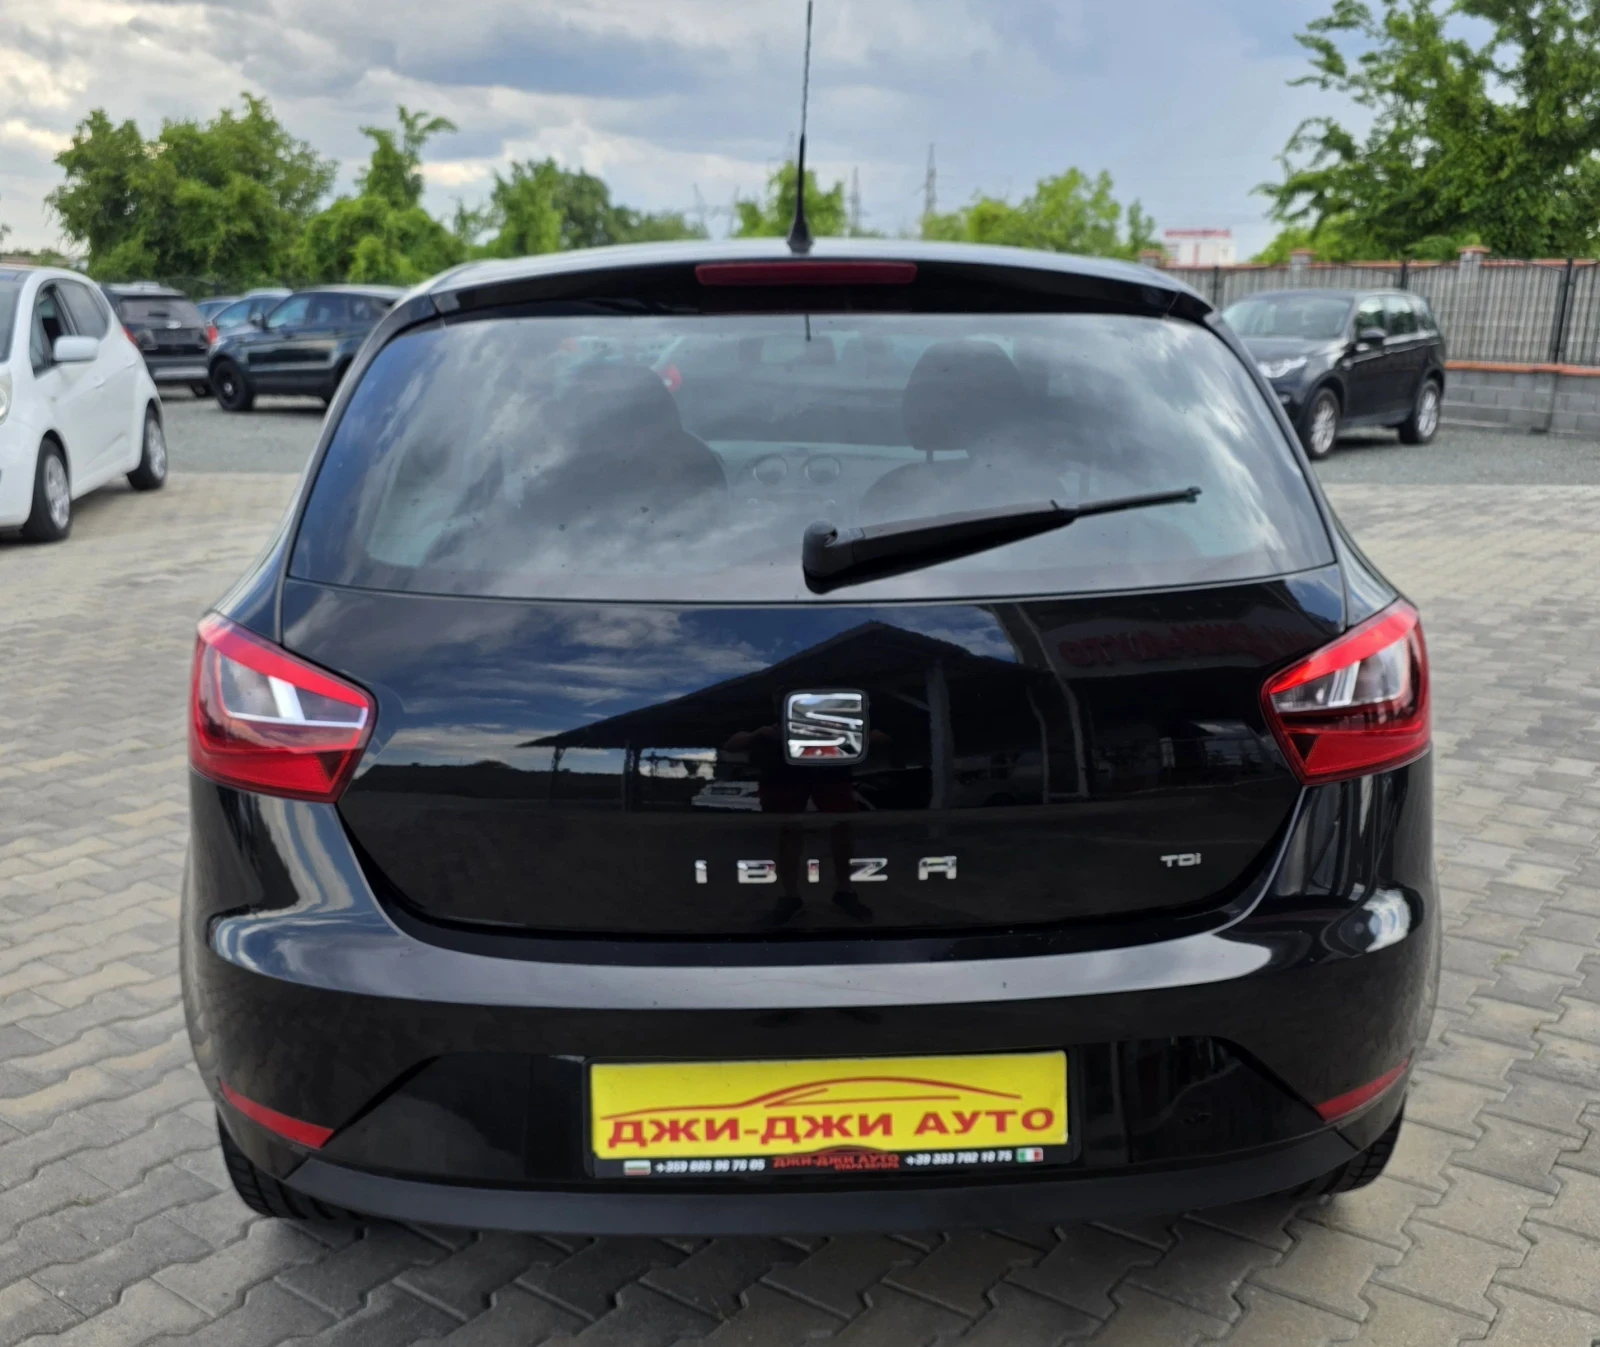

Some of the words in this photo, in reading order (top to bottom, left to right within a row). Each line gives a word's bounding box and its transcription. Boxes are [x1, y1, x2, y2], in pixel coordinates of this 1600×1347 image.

[694, 856, 957, 883] IBIZA
[607, 1111, 893, 1149] ДЖИ-ДЖИ
[913, 1107, 1056, 1136] АУТО
